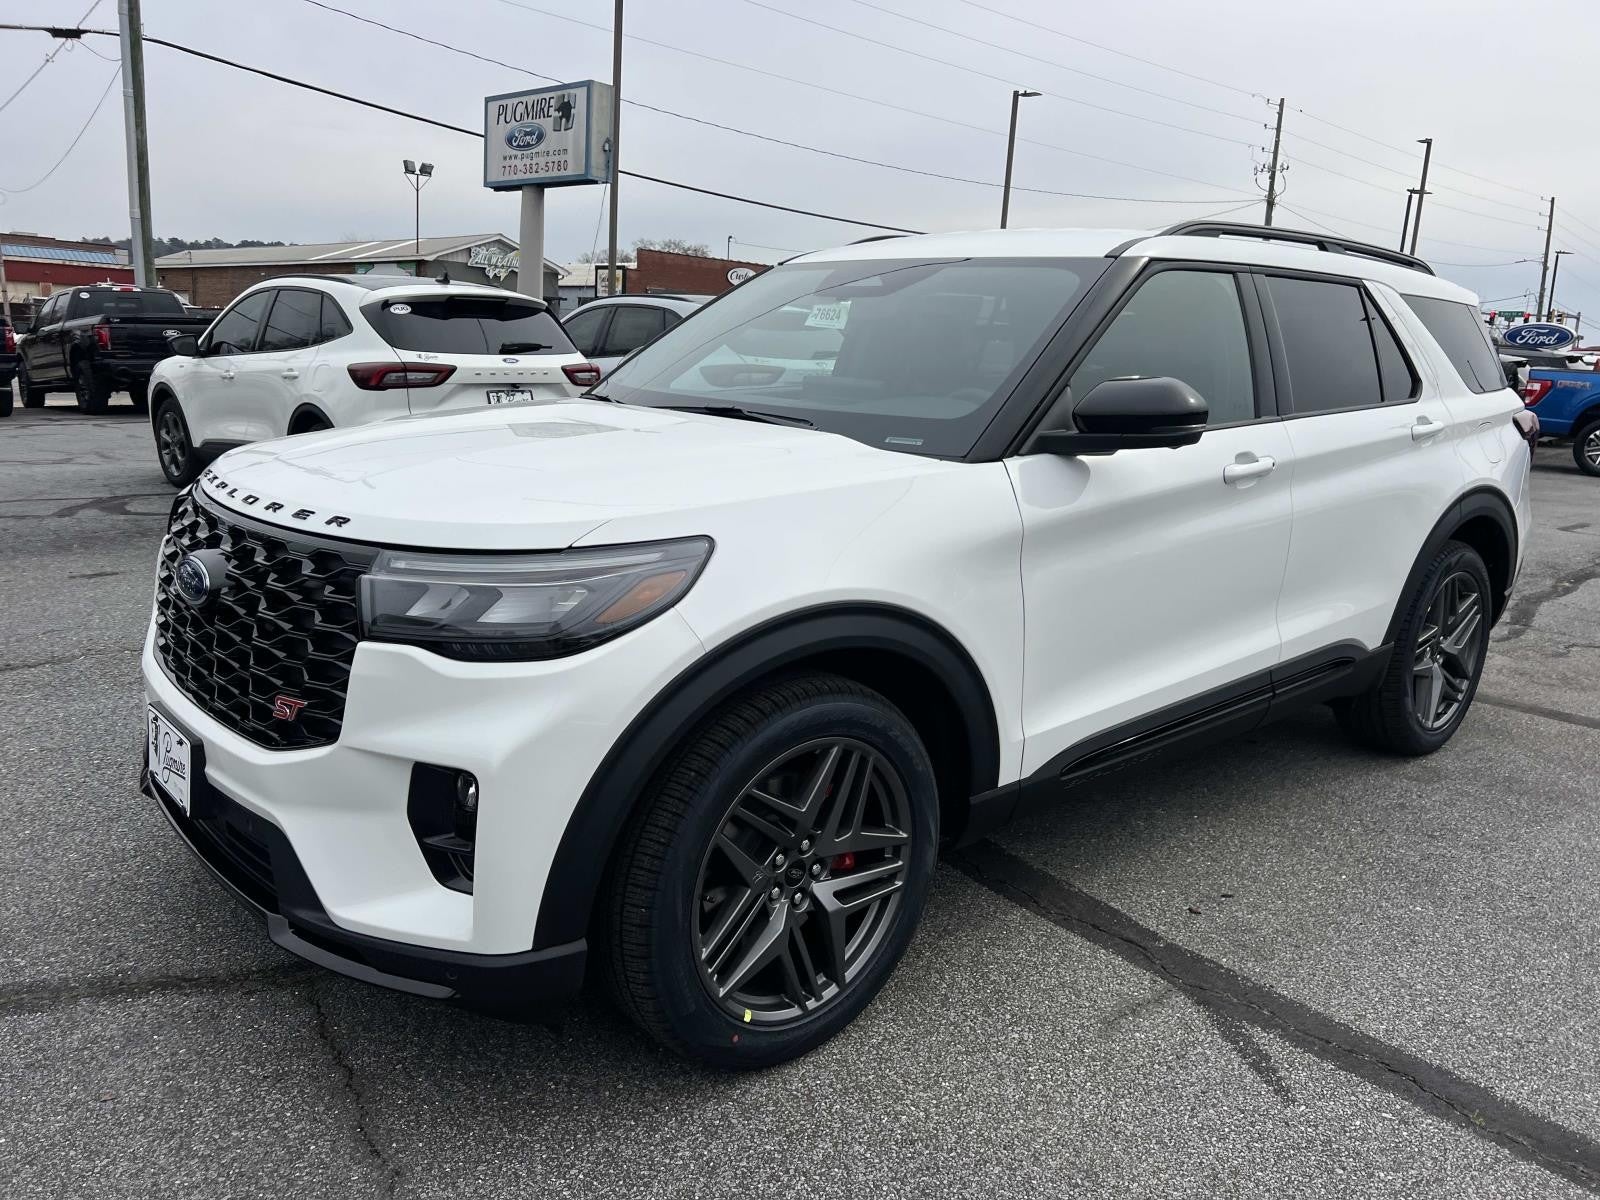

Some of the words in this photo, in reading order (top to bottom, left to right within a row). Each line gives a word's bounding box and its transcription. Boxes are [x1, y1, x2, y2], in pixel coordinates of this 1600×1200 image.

[496, 97, 554, 125] PUGMIRE
[512, 127, 538, 146] Ford
[502, 148, 568, 161] www.pugmire.com
[502, 160, 568, 176] 770-382-5780
[1516, 328, 1560, 344] Ford
[203, 469, 351, 527] EXPLORER
[273, 695, 307, 721] ST
[162, 731, 186, 783] Pugmire
